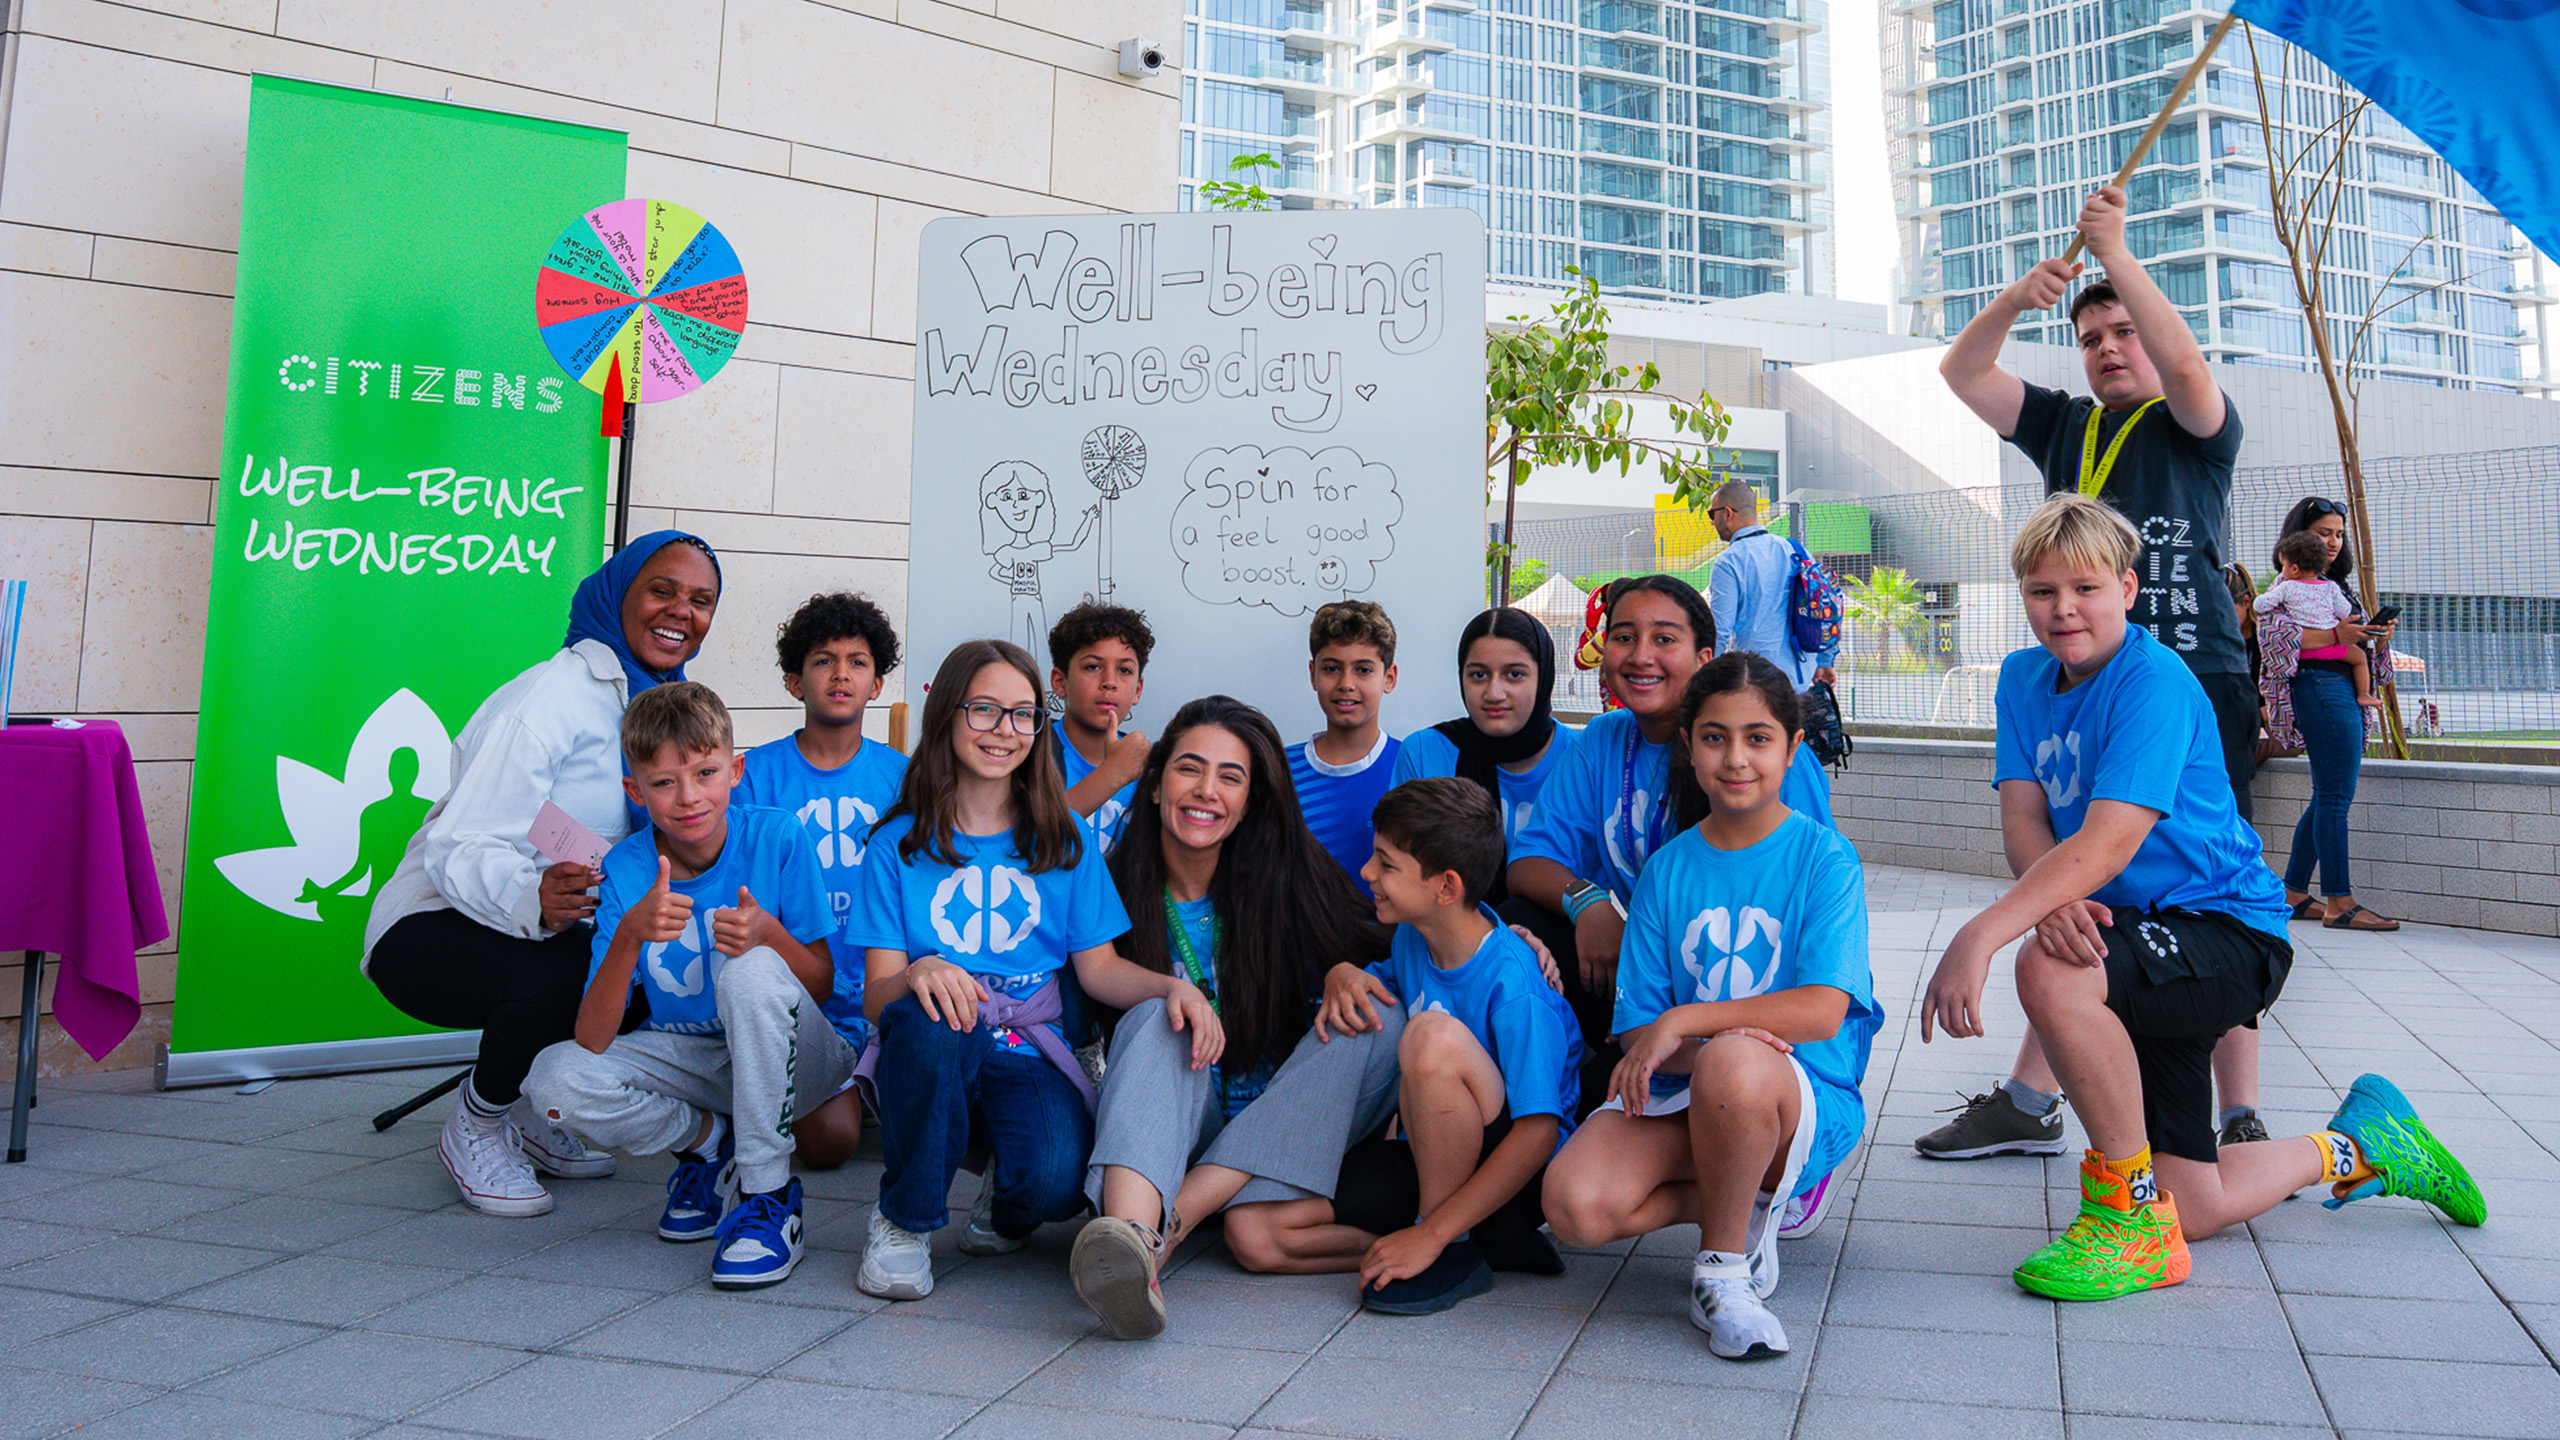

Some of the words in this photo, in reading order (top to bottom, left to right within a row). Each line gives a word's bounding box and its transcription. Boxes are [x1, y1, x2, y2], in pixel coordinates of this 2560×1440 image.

[602, 231, 624, 252] your
[648, 236, 659, 261] star
[673, 258, 685, 271] do
[685, 240, 699, 260] you
[699, 228, 710, 241] do
[547, 252, 578, 269] great
[568, 249, 597, 265] about
[618, 253, 628, 264] is
[592, 271, 610, 284] me
[600, 261, 623, 282] thing
[627, 266, 641, 287] Who
[670, 275, 682, 288] to
[594, 292, 620, 306] Hug
[613, 281, 632, 296] Tell
[665, 291, 691, 303] High
[960, 223, 1445, 356] Well-being
[604, 325, 616, 339] an
[633, 318, 644, 337] Ten
[646, 311, 661, 330] Tell
[658, 331, 670, 346] me
[658, 306, 686, 322] Teach
[689, 319, 703, 329] me
[715, 328, 739, 340] word
[671, 321, 681, 329] in
[569, 314, 616, 363] compliment
[583, 339, 605, 365] adult
[631, 340, 641, 375] second
[278, 354, 565, 414] CITIZENS
[924, 324, 1343, 433] Wednesday
[239, 453, 584, 520] WELL-BEING
[1204, 466, 1295, 518] Spin
[1313, 467, 1359, 503] for
[244, 518, 557, 578] WEDNESDAY
[1182, 523, 1199, 547] a
[1217, 515, 1279, 552] feel
[1307, 518, 1370, 556] good
[1622, 768, 1630, 806] CITIZENS
[1179, 938, 1201, 980] CITIZENS
